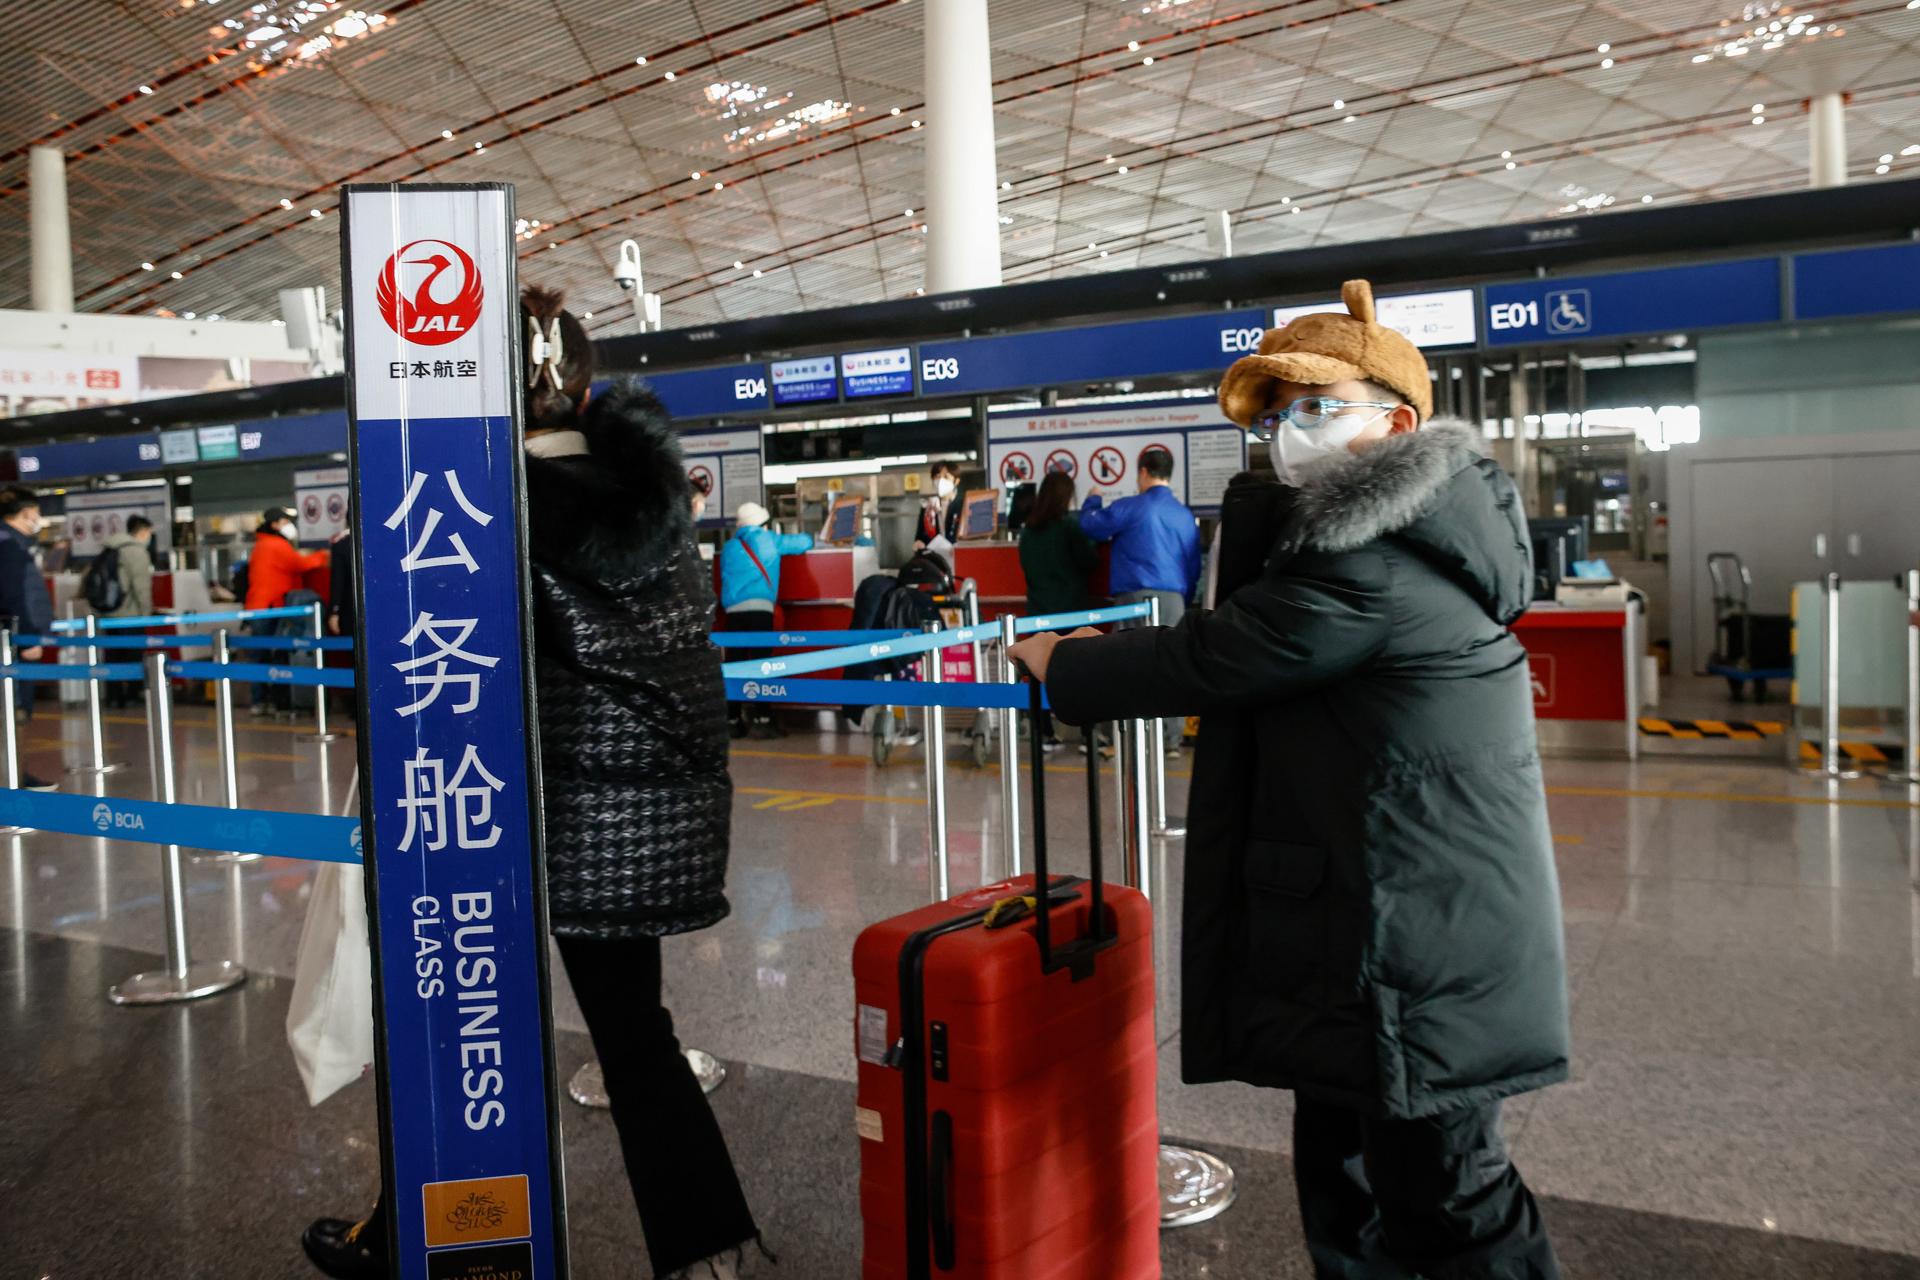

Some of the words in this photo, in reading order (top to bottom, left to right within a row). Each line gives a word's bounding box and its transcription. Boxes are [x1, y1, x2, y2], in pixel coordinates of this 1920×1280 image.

[407, 315, 465, 333] JAL
[1491, 300, 1539, 330] E01
[1220, 327, 1263, 353] E02
[389, 359, 478, 379] 日本航空
[922, 357, 959, 381] E03
[734, 378, 767, 400] E04
[384, 469, 506, 852] 公务舱
[761, 684, 787, 697] BCIA
[115, 812, 145, 830] BCIA
[411, 895, 445, 999] CLASS
[451, 891, 506, 1131] BUSINESS
